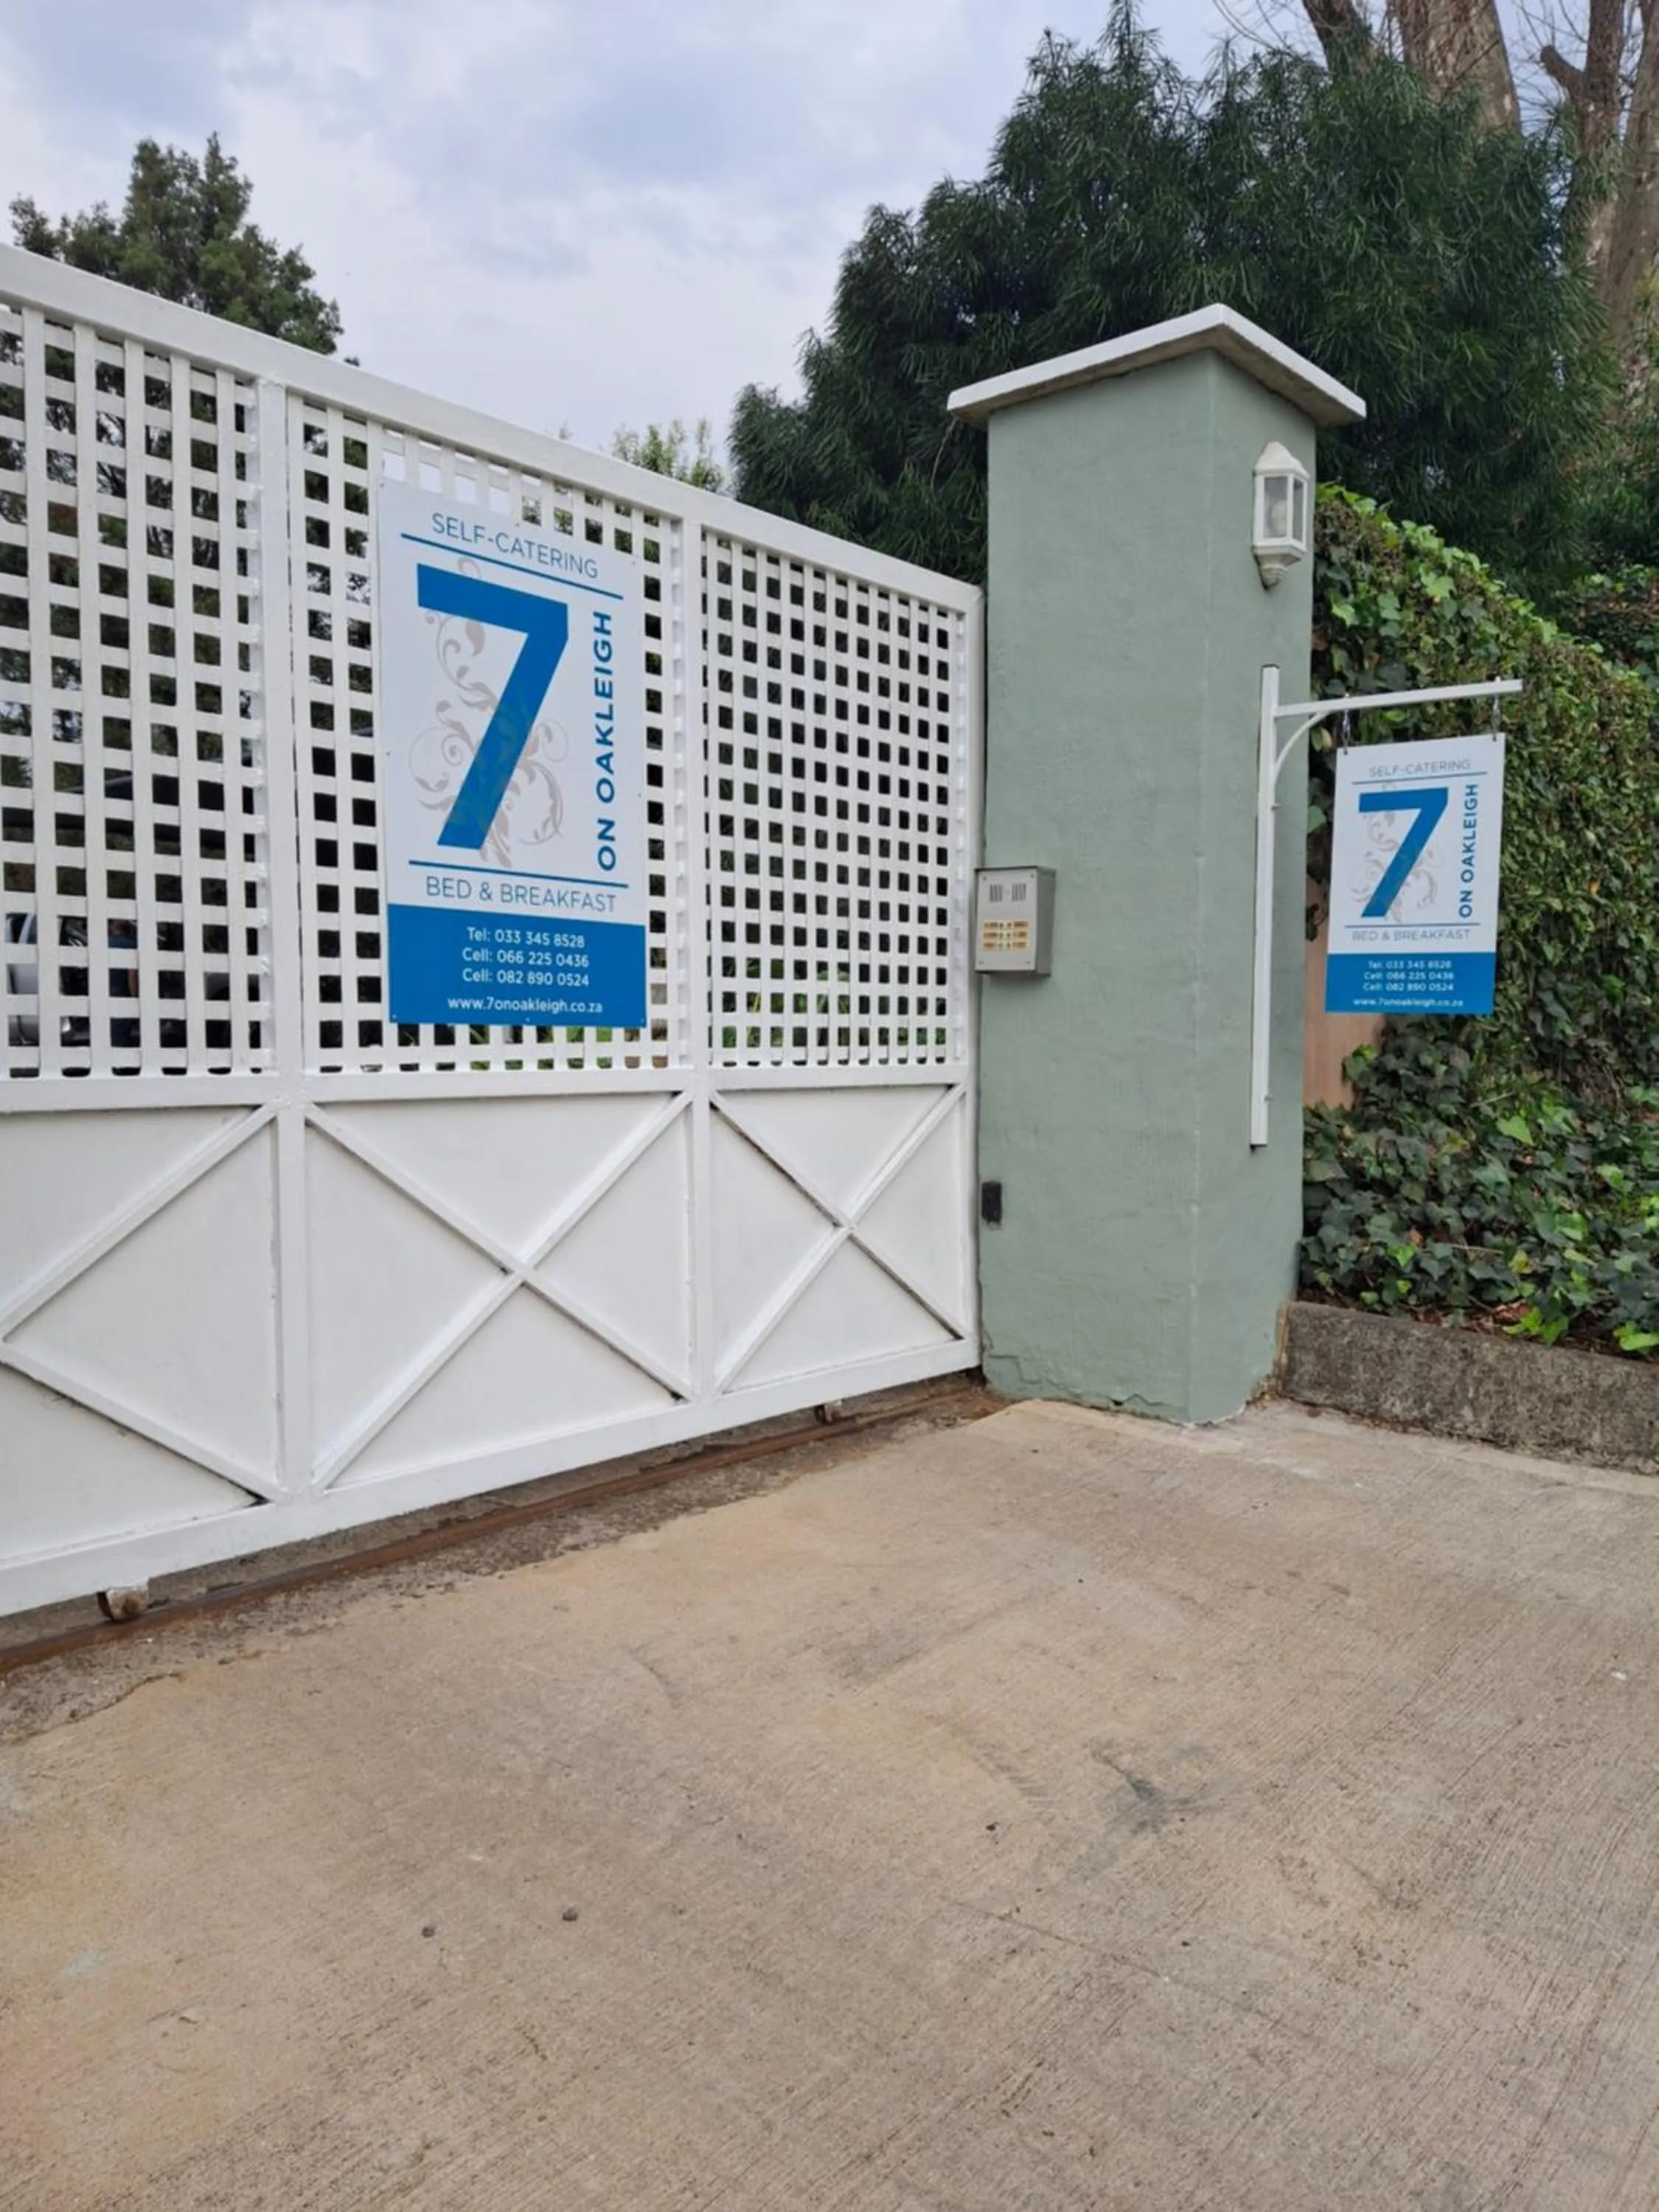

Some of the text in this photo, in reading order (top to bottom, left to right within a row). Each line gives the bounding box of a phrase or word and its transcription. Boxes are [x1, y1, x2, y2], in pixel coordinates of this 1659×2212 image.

[431, 512, 599, 579] SELF-CATERING
[417, 563, 569, 850] 7
[593, 611, 616, 872] ON OAKLEIGH
[1369, 759, 1472, 778] SELF-CATERING
[1358, 787, 1450, 919] 7
[1458, 783, 1478, 919] ON OAKLEIGH
[425, 875, 618, 914] BED & BREAKFAST
[467, 926, 585, 949] Tel: 033 345 8528
[1352, 930, 1379, 942] BED
[1394, 928, 1471, 942] BREAKFAST
[462, 947, 589, 968] Cell: 066 225 0436
[462, 967, 590, 988] Cell: 082 890 0524
[448, 995, 603, 1015] www.7onoakleigh.co.za
